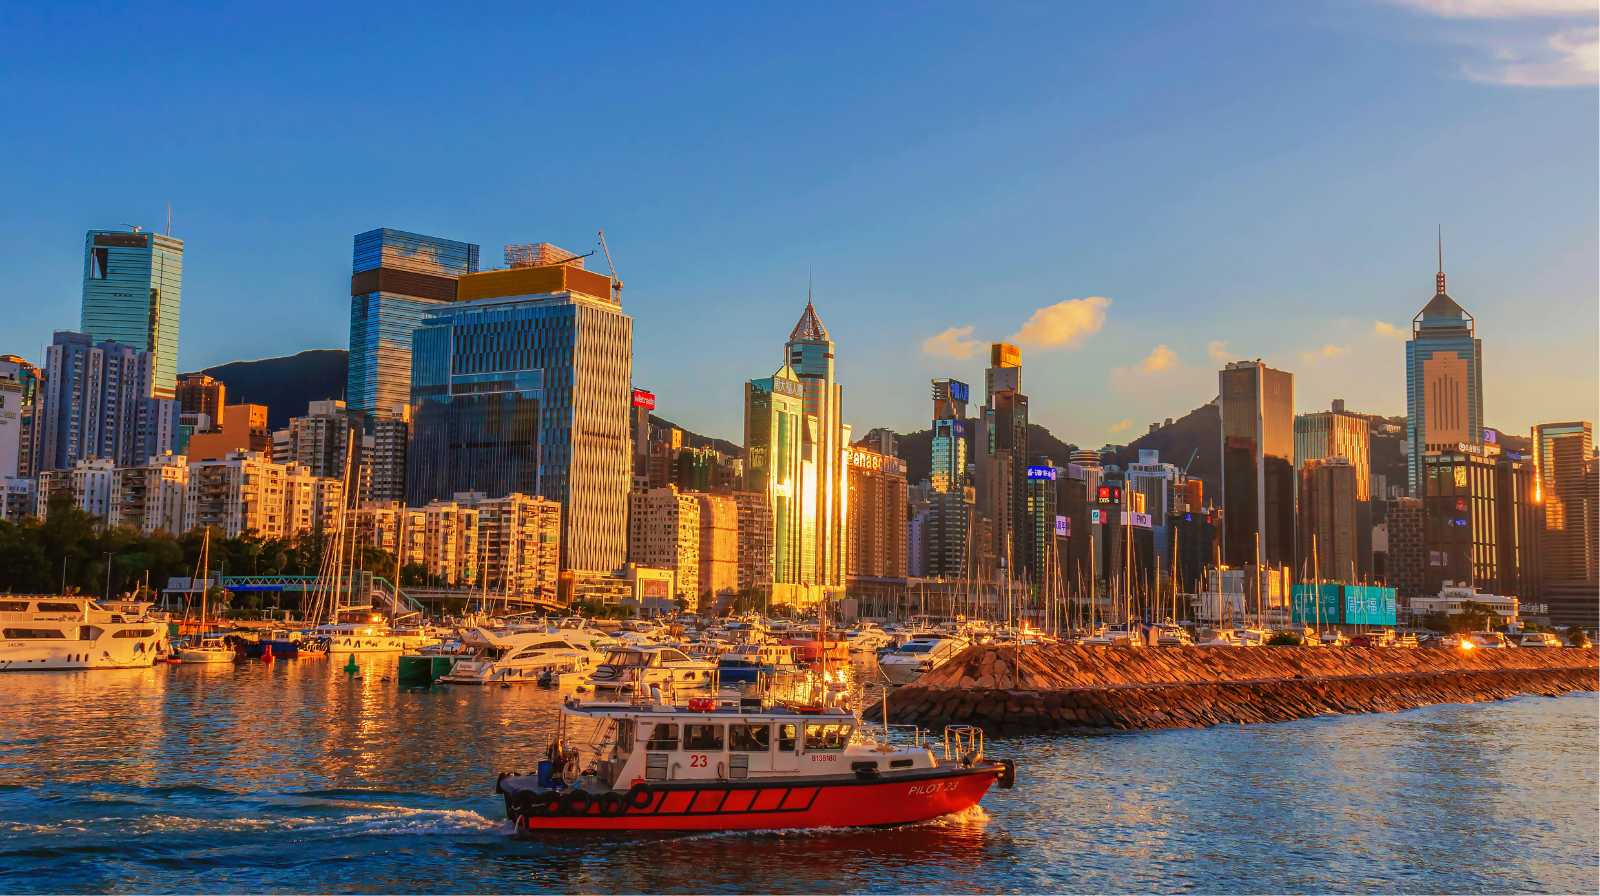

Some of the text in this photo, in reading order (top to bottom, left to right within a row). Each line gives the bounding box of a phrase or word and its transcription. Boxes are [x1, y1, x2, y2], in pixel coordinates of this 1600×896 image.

[690, 754, 708, 768] 23
[907, 780, 960, 797] PILOT 23
